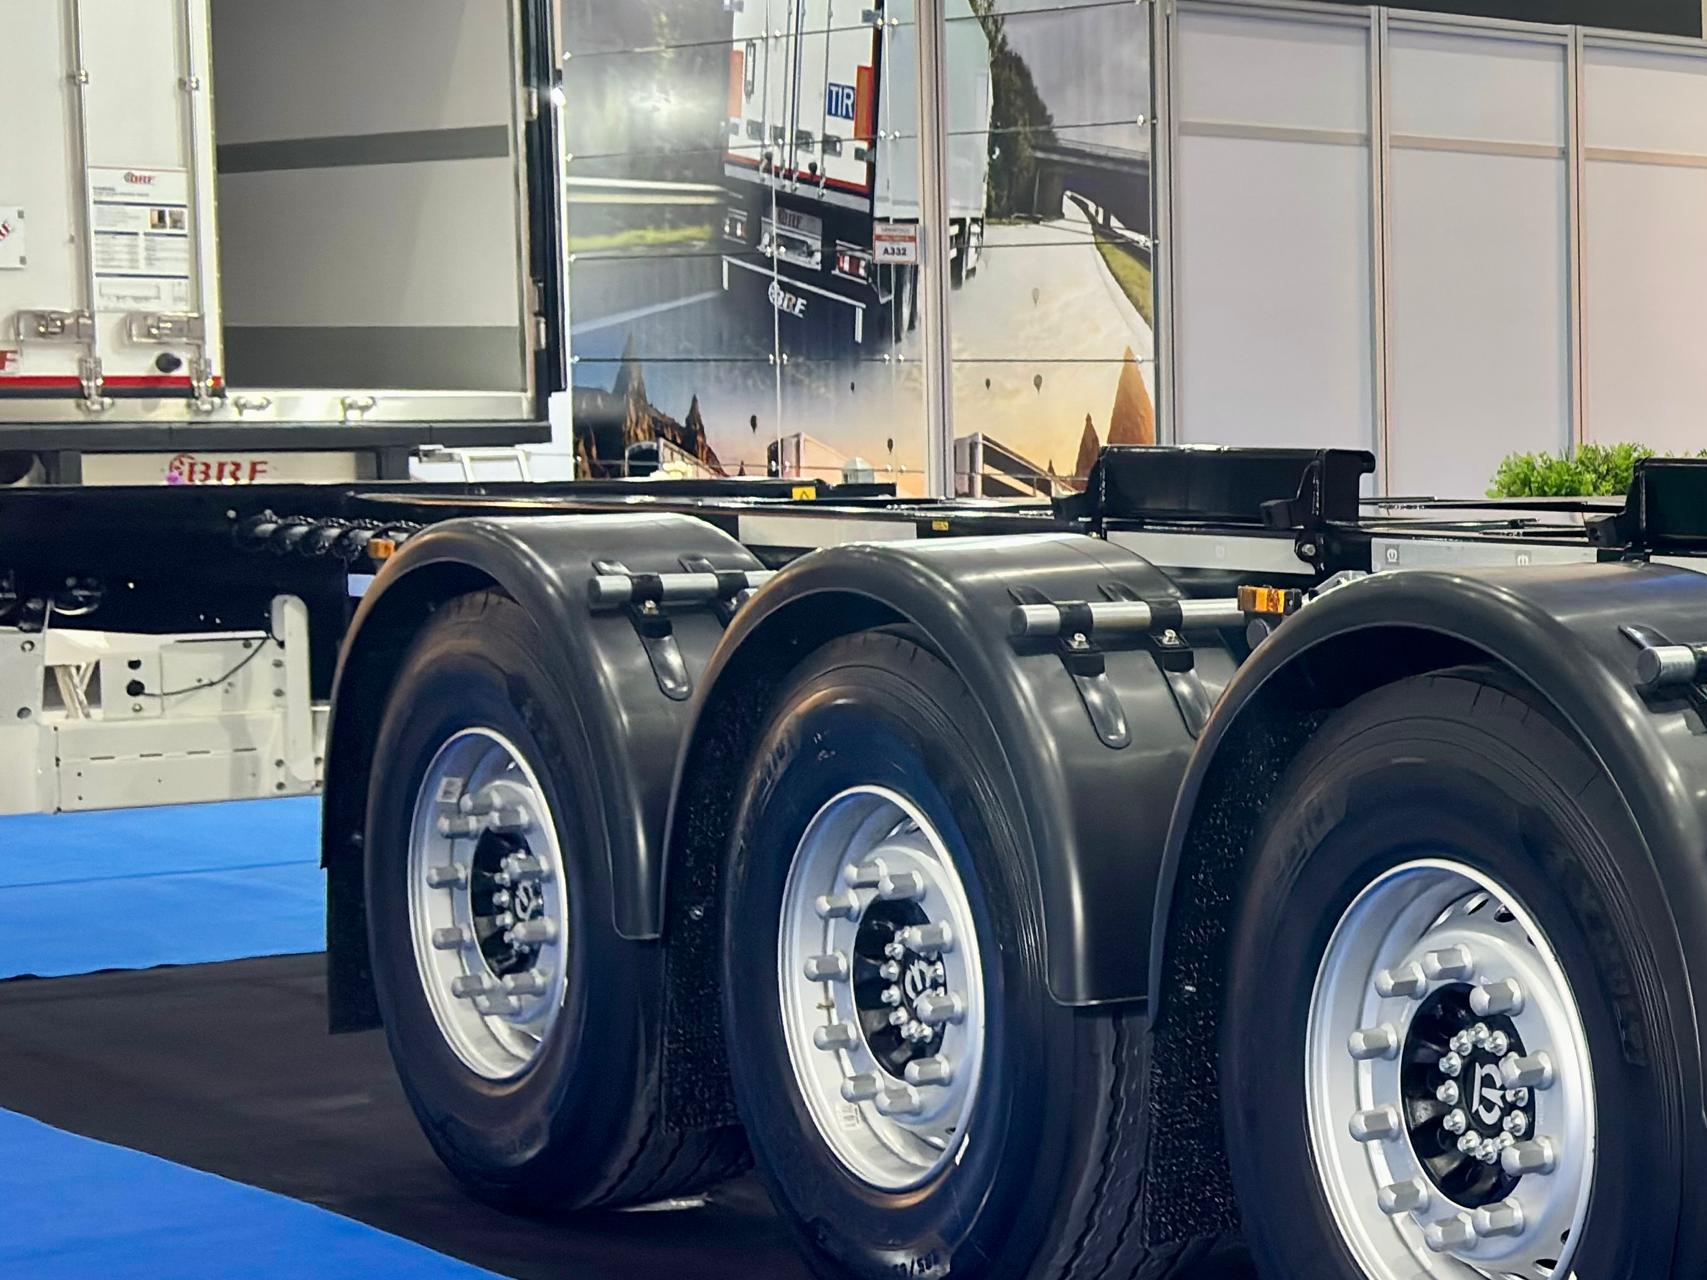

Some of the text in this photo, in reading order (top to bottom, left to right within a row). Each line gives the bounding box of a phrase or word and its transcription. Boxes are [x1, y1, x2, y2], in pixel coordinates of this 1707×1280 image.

[829, 85, 855, 119] TIR
[882, 245, 907, 257] A332
[187, 460, 268, 483] BRF
